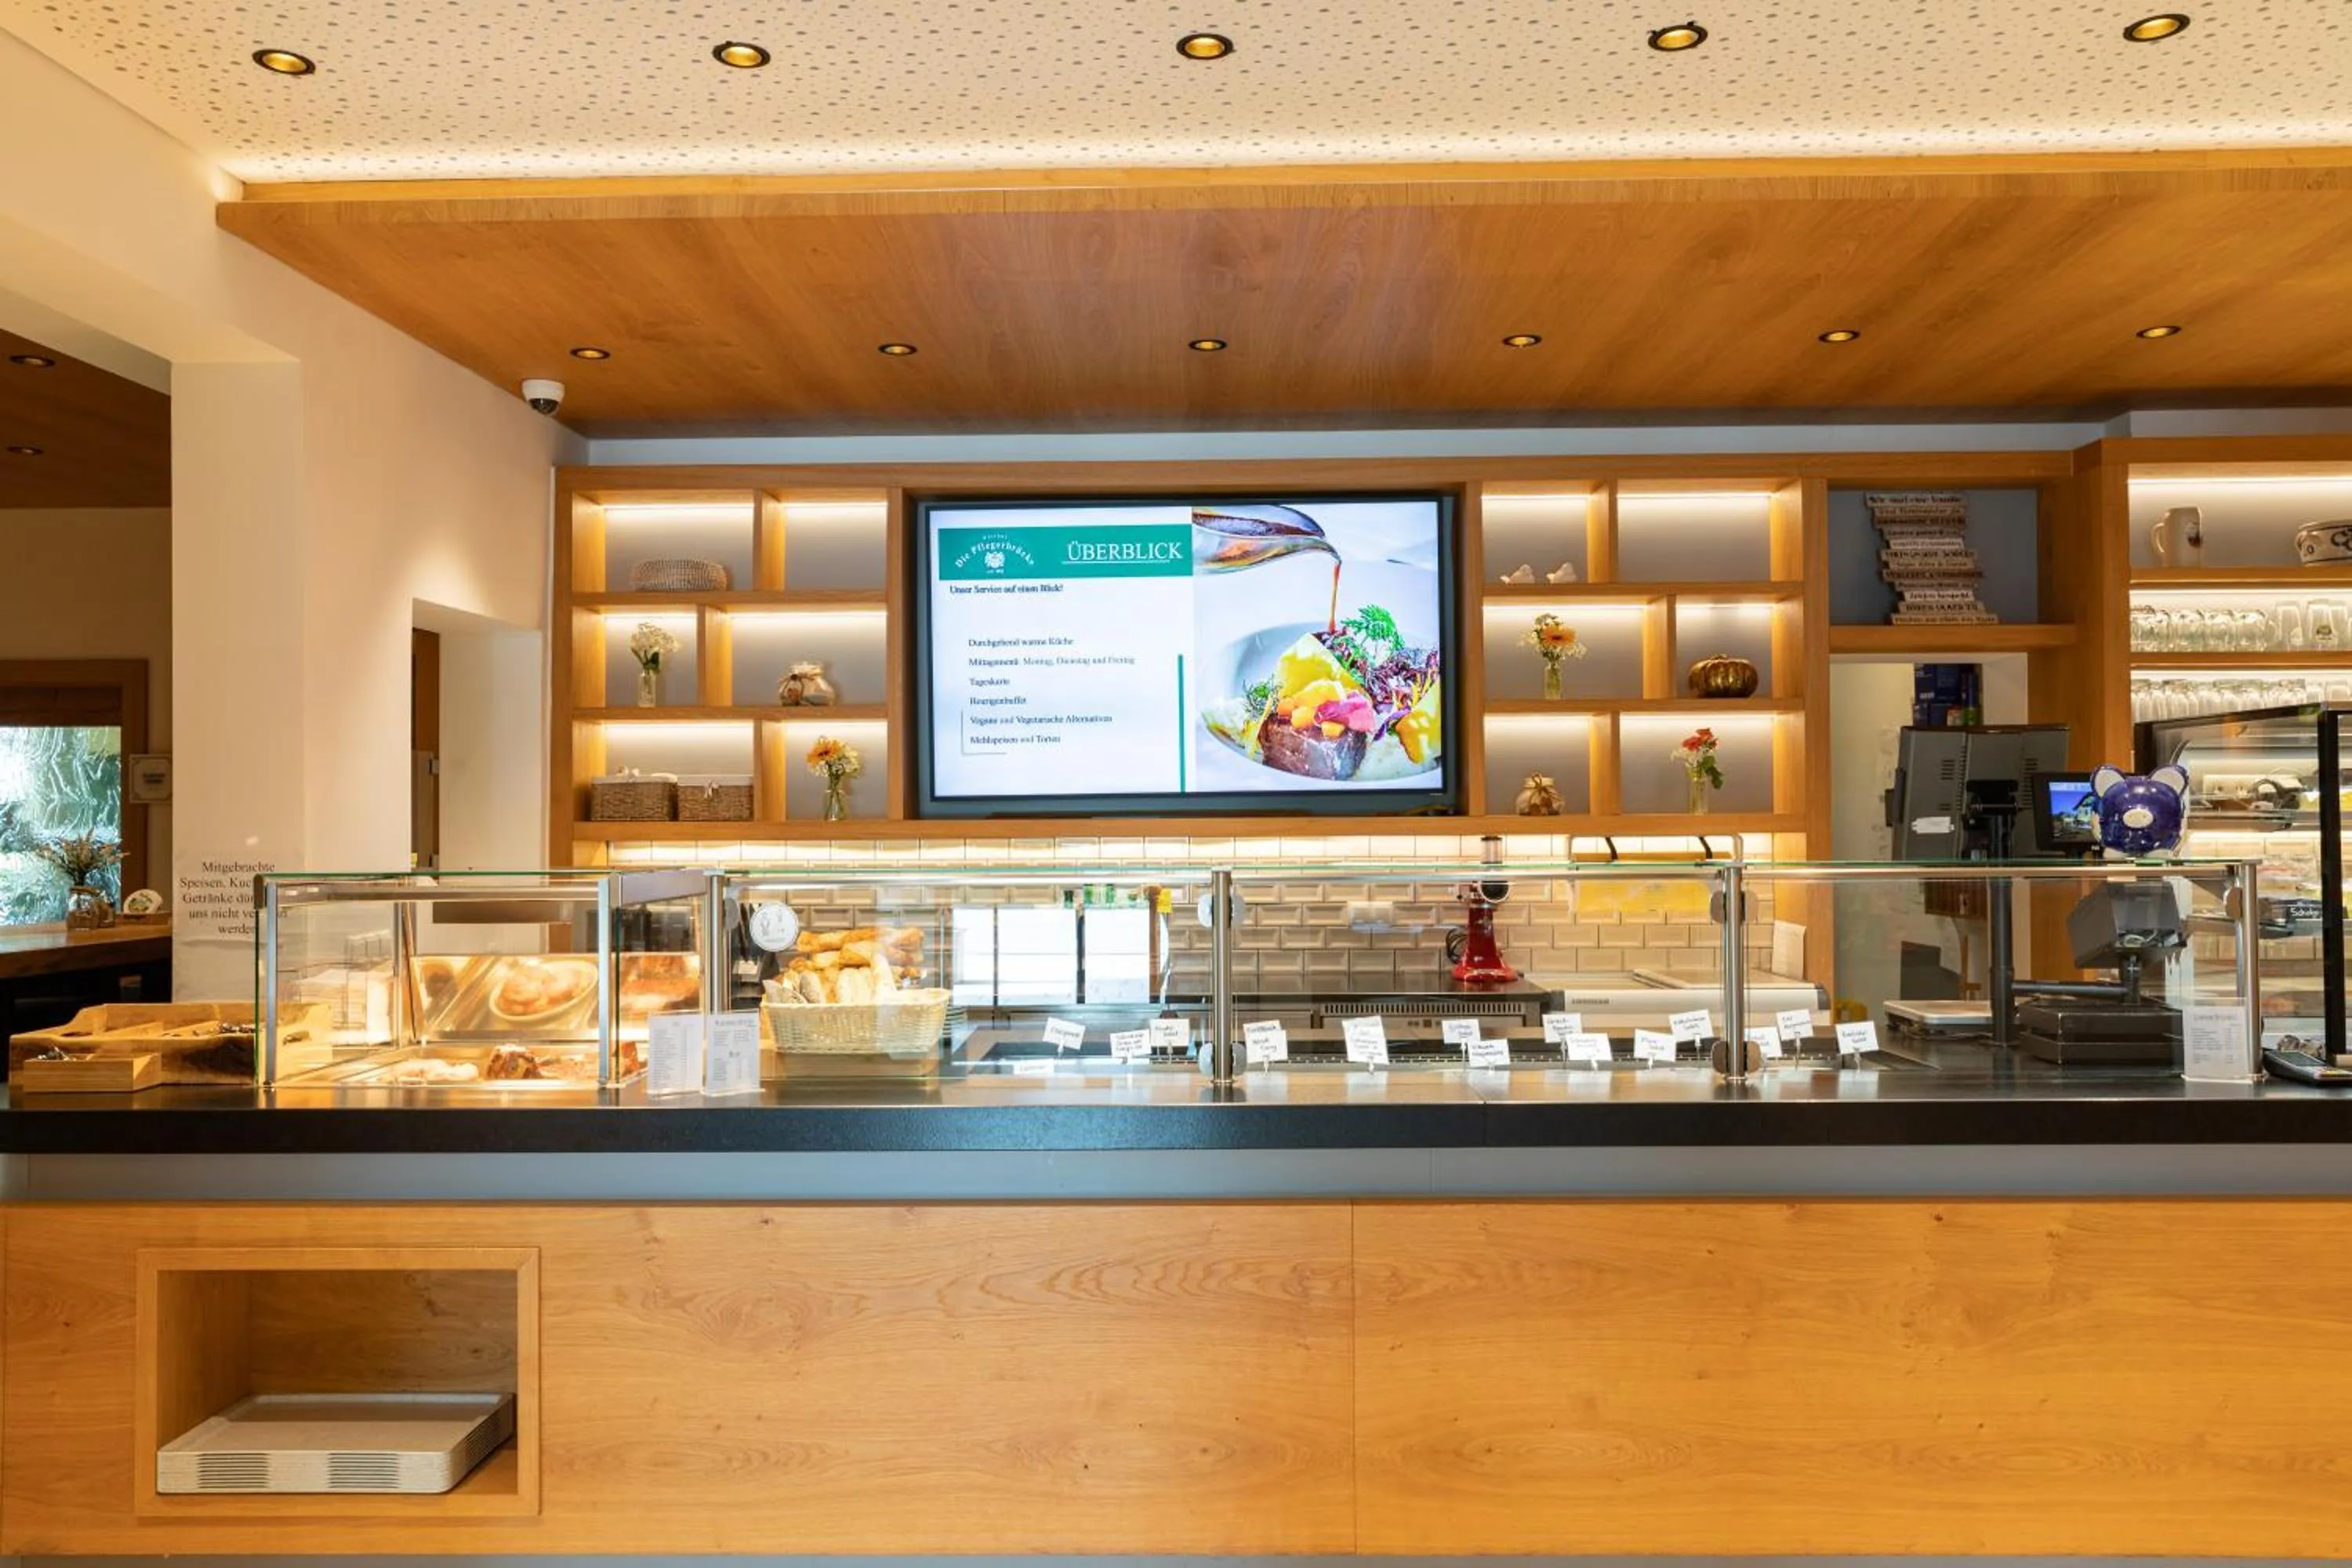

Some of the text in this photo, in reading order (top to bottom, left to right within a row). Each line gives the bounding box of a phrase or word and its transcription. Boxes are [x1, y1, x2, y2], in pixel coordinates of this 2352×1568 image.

[1068, 540, 1183, 561] ÜBERBLICK
[949, 585, 972, 594] Unser
[974, 584, 1002, 593] Service
[1003, 584, 1016, 593] auf
[202, 862, 275, 874] Mitgebrachte
[182, 893, 233, 904] Getränke
[189, 910, 209, 919] uns
[211, 908, 239, 919] nicht
